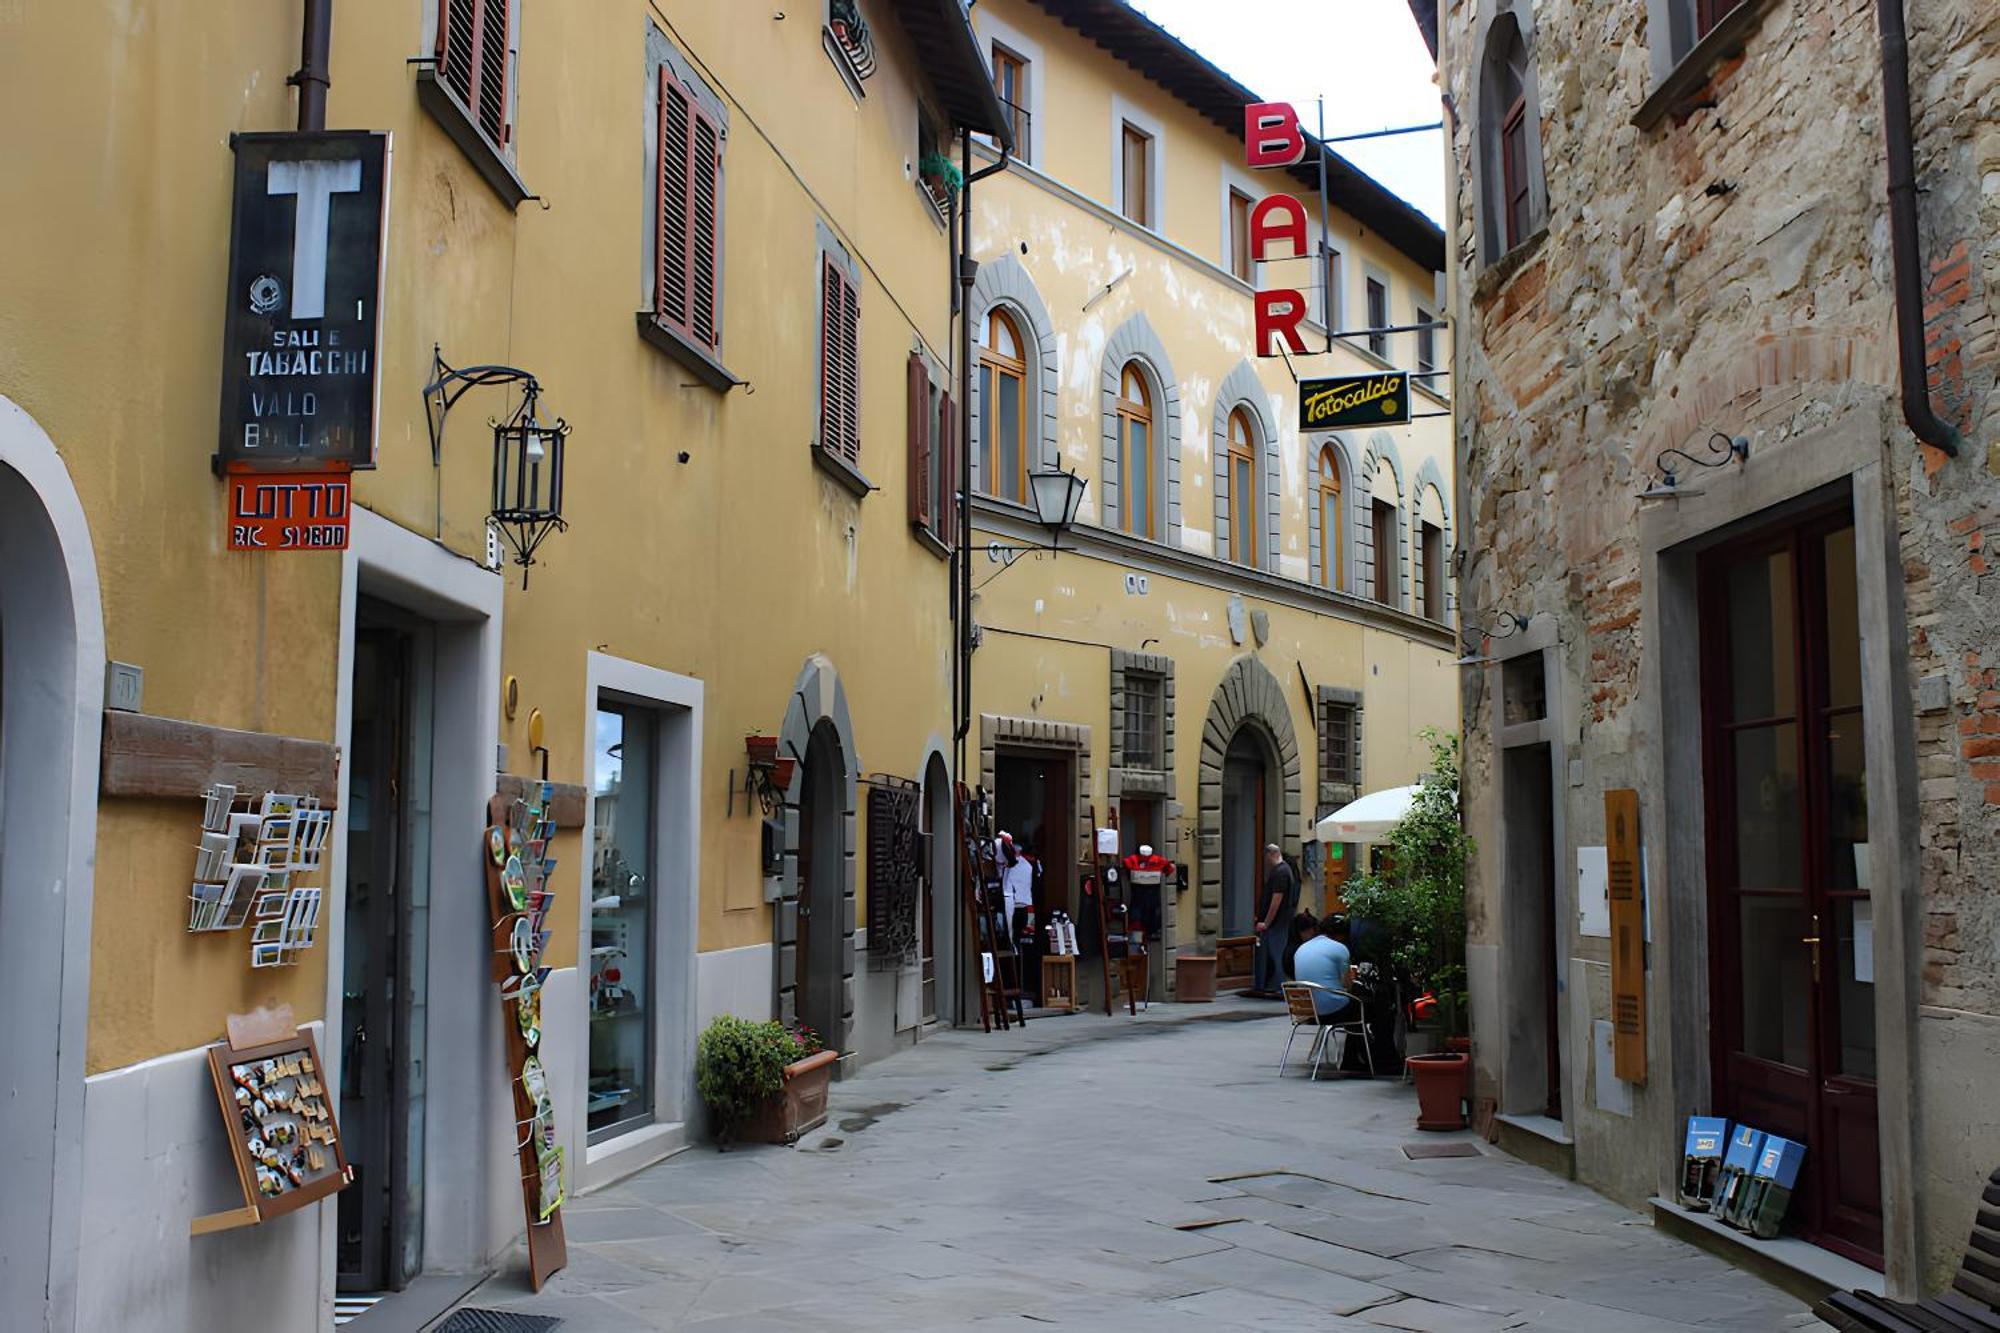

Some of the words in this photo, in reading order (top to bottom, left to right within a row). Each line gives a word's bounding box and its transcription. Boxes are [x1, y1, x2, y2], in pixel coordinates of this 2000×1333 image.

[267, 159, 362, 320] T
[1245, 102, 1308, 357] BAR
[245, 349, 368, 377] TABACCHI
[235, 483, 347, 520] LOTTO
